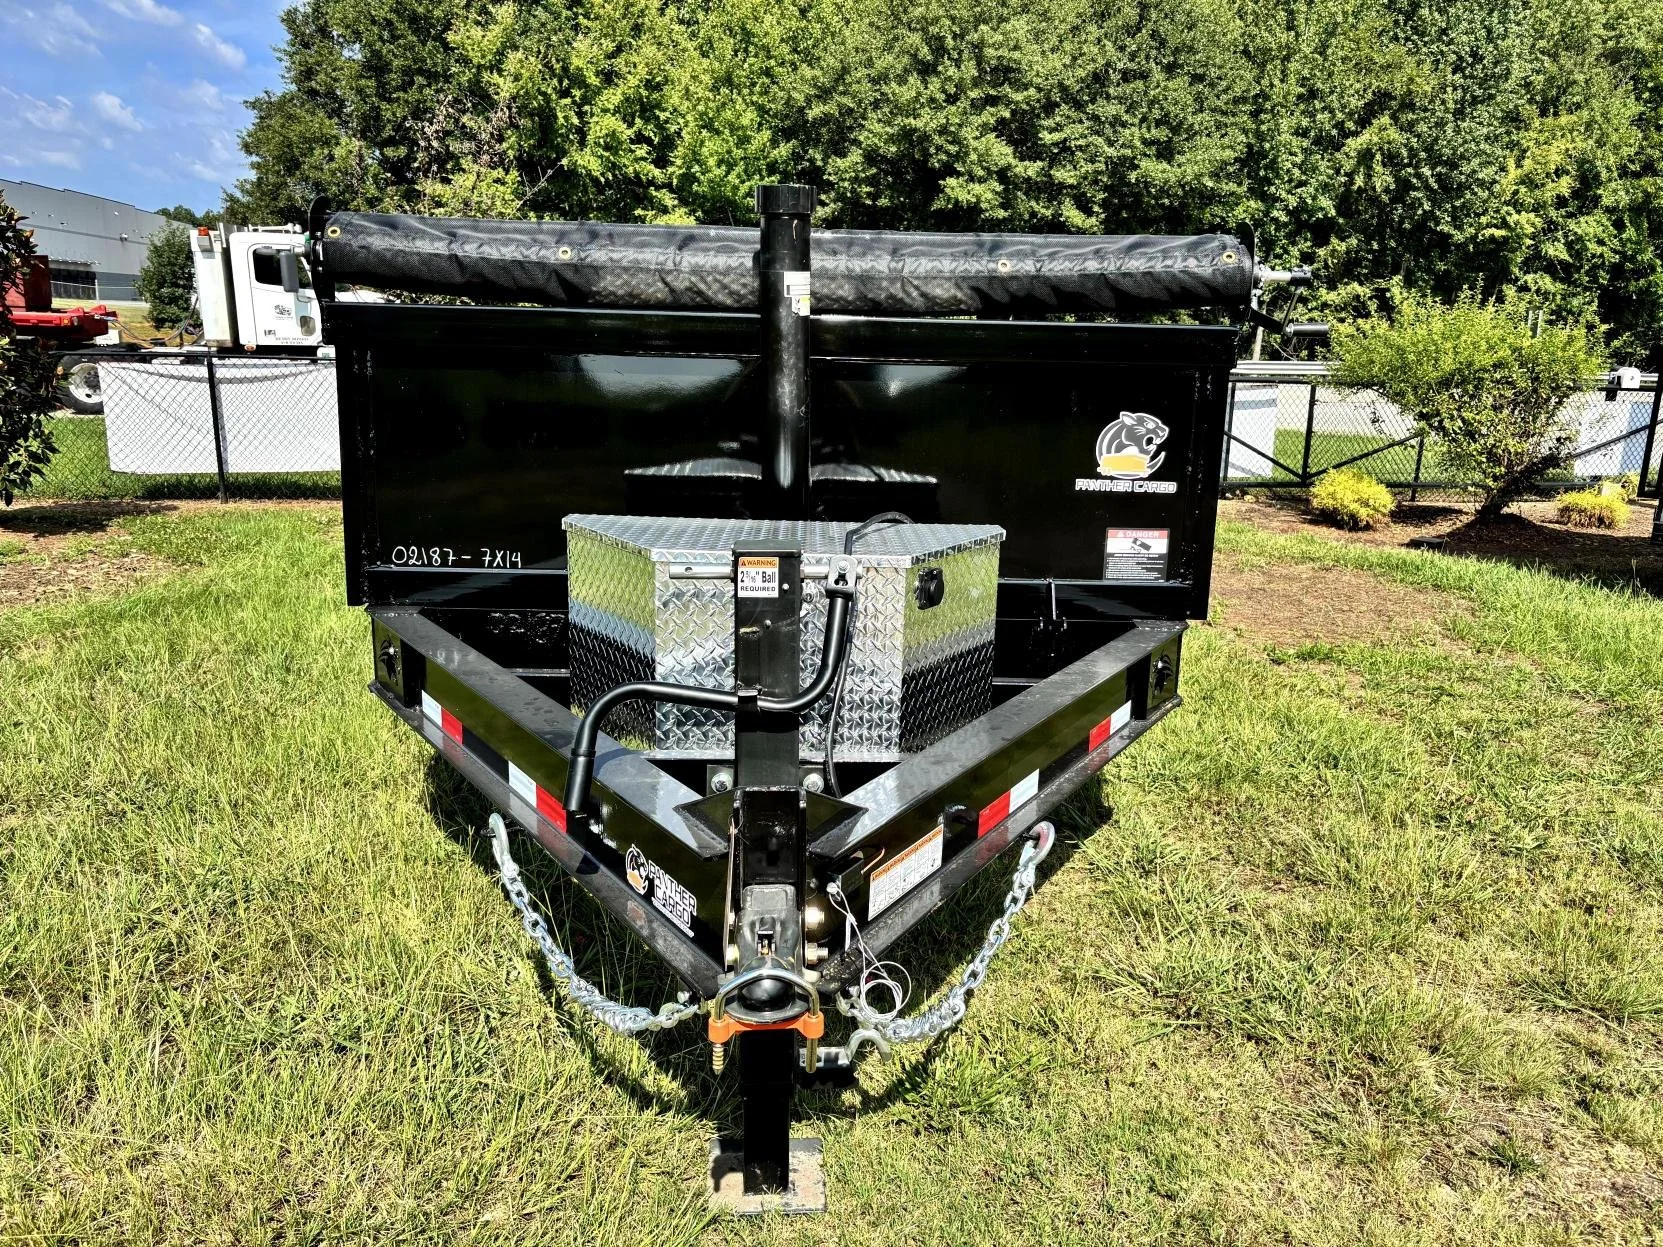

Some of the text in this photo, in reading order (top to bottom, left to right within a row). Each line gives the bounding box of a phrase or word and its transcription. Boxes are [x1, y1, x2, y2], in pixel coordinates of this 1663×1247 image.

[1075, 478, 1177, 494] PANTHER CARGO
[1126, 530, 1160, 538] DANGER
[747, 559, 776, 567] WARNING
[761, 570, 776, 583] Ball
[648, 859, 697, 916] PANTHER
[654, 883, 692, 928] CARGO
